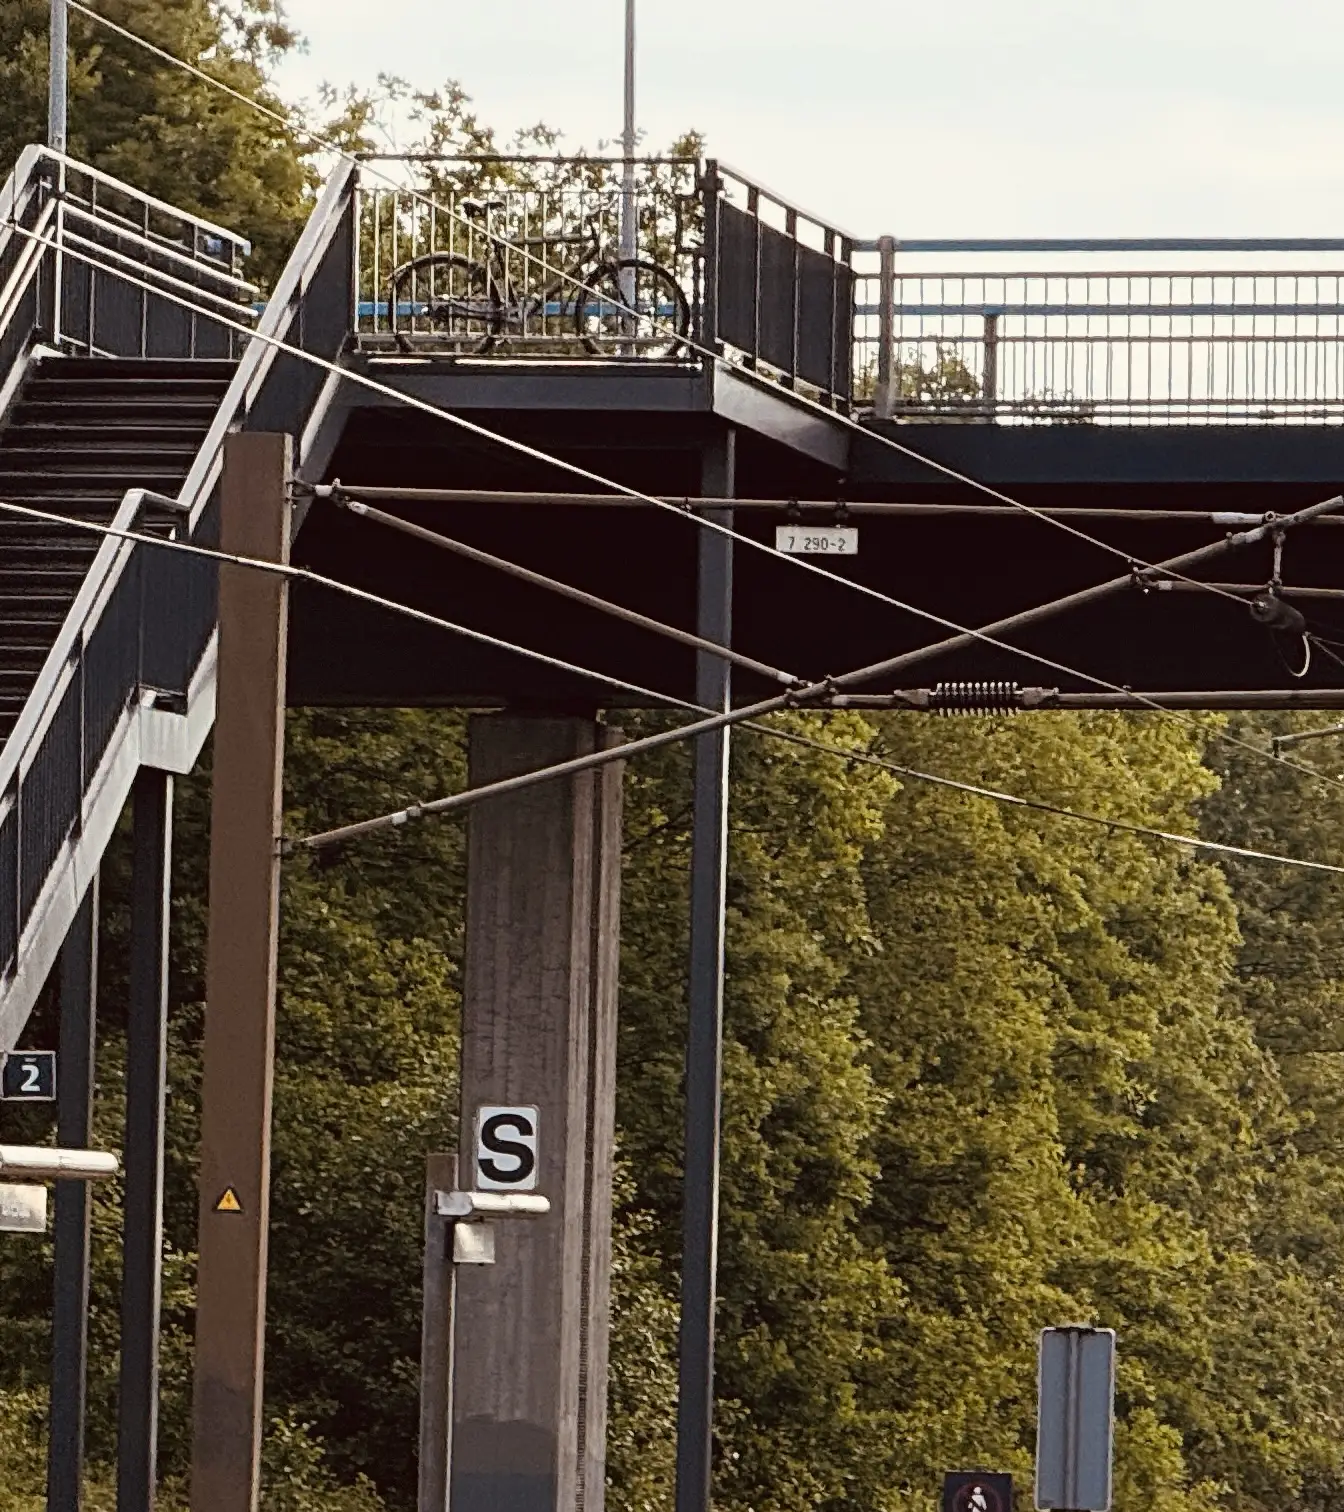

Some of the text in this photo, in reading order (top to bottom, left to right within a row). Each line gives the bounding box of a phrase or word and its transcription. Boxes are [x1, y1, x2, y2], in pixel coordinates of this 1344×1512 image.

[787, 536, 846, 551] 7 290-2
[20, 1064, 41, 1092] 2
[477, 1113, 535, 1183] S
